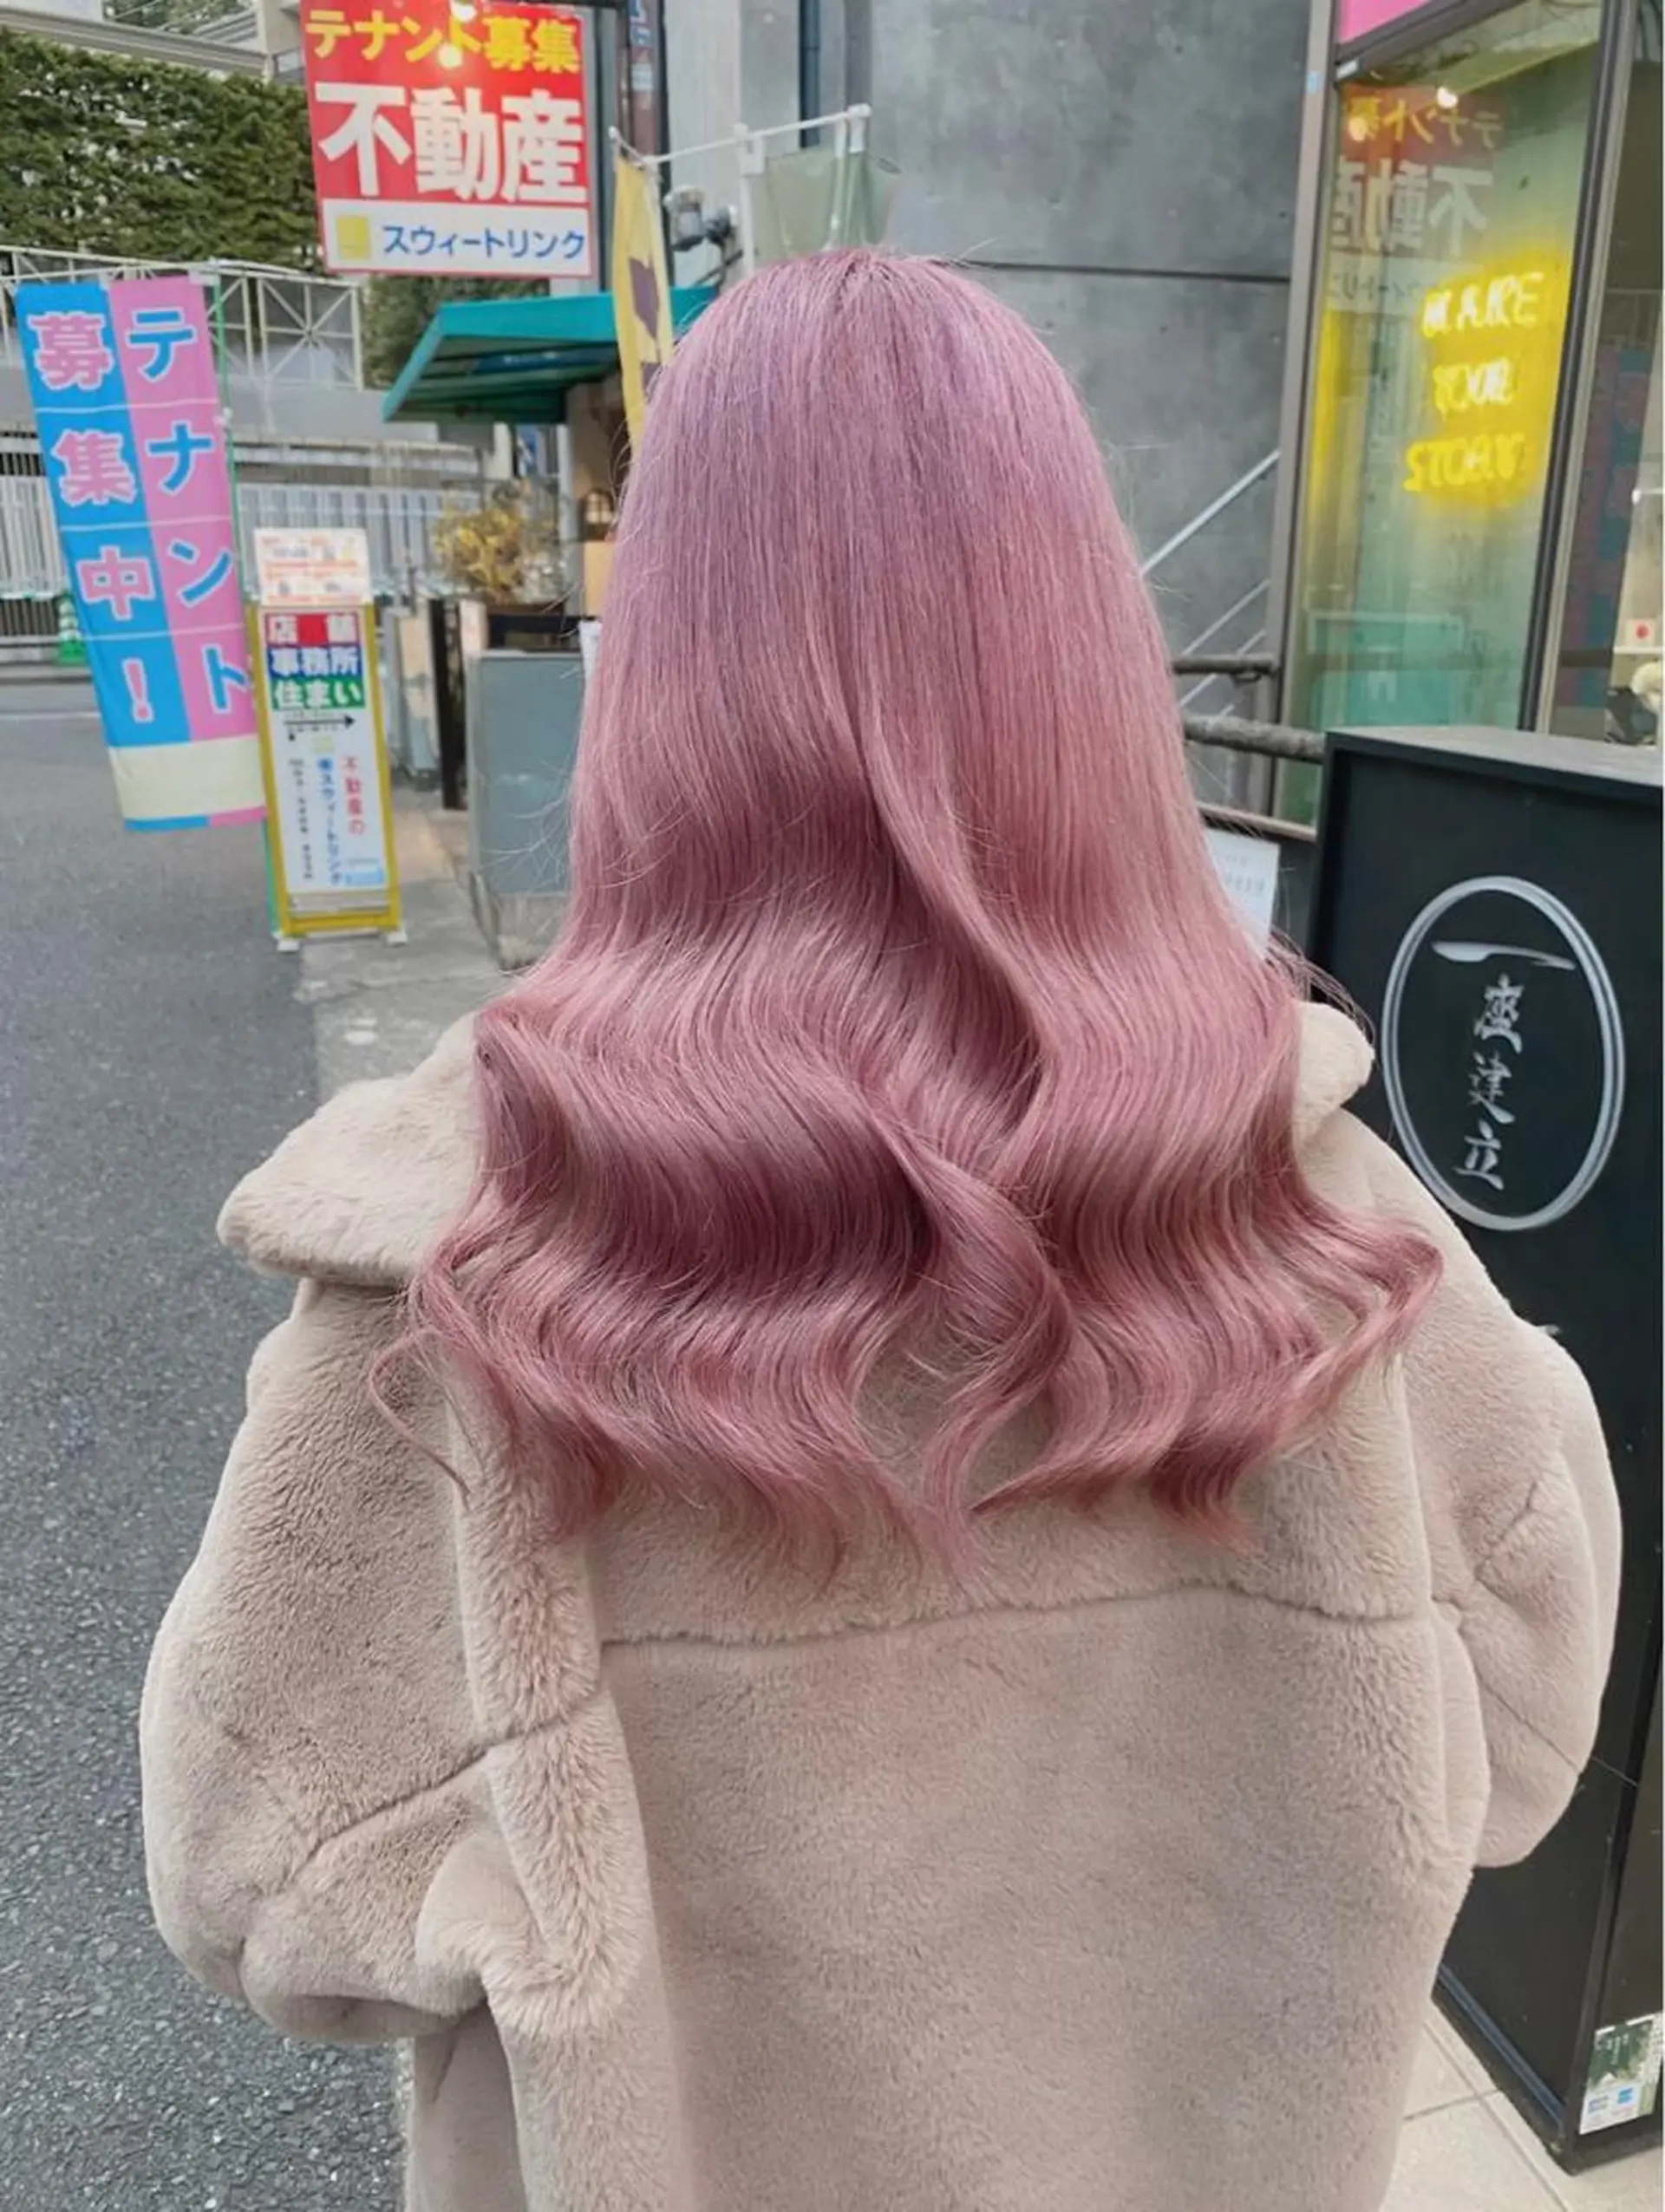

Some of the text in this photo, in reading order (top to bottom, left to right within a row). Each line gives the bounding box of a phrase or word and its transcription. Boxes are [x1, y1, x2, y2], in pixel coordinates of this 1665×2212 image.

[306, 10, 581, 74] テナント募集
[314, 82, 588, 204] 不動産
[382, 225, 585, 259] スウィートリンク
[1422, 271, 1546, 339] MAKE
[126, 306, 251, 714] テナント
